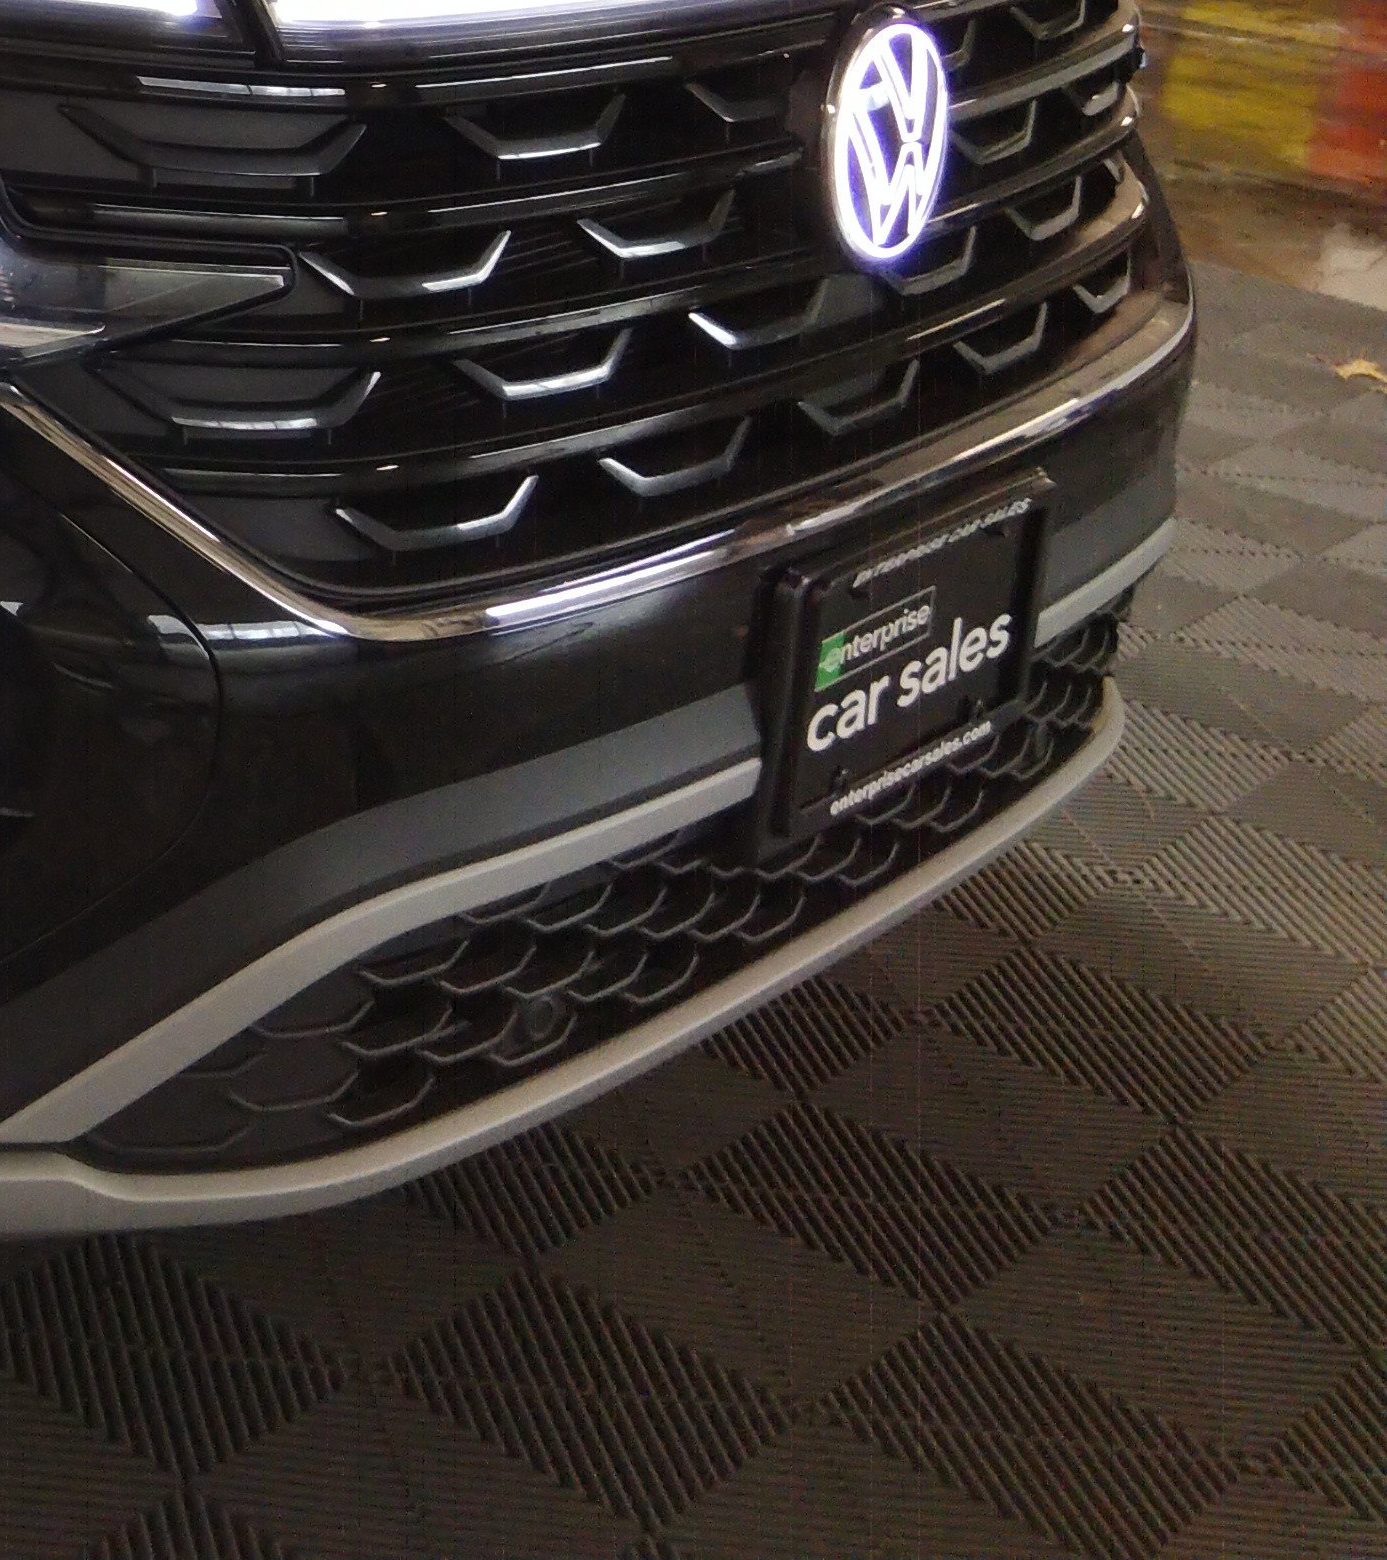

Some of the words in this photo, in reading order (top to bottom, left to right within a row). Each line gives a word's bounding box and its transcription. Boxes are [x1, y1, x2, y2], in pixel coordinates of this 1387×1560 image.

[806, 674, 891, 752] car
[896, 613, 1013, 708] sales
[819, 602, 931, 673] enterprise
[829, 720, 992, 816] enterprisecarsales.com
